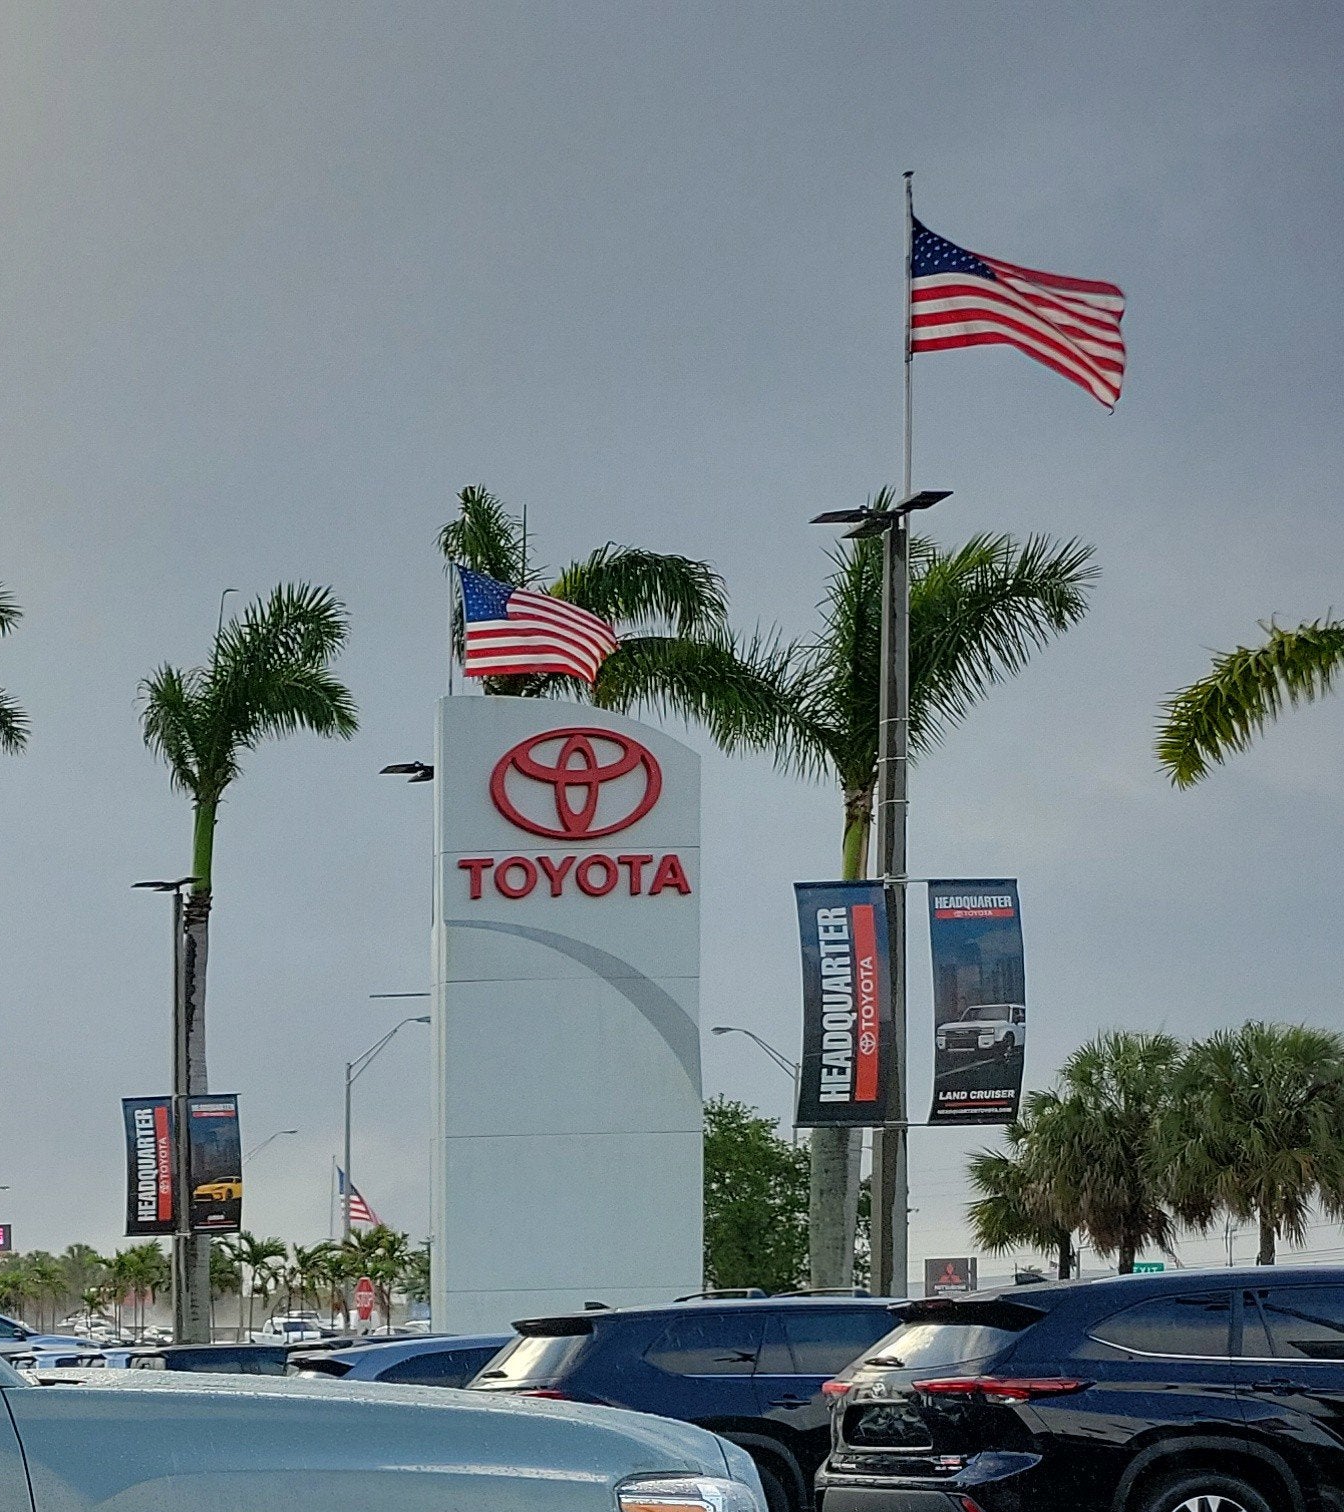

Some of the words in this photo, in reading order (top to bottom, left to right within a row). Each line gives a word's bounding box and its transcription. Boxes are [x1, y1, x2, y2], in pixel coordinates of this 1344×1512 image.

[457, 854, 692, 900] TOYOTA
[934, 896, 1012, 910] HEADQUARTER
[816, 907, 857, 1103] HEADQUARTER
[860, 956, 875, 1031] TOYOTA
[938, 1091, 968, 1101] LAND
[969, 1089, 1015, 1100] CRUISER
[134, 1108, 159, 1222] HEADQUARTER
